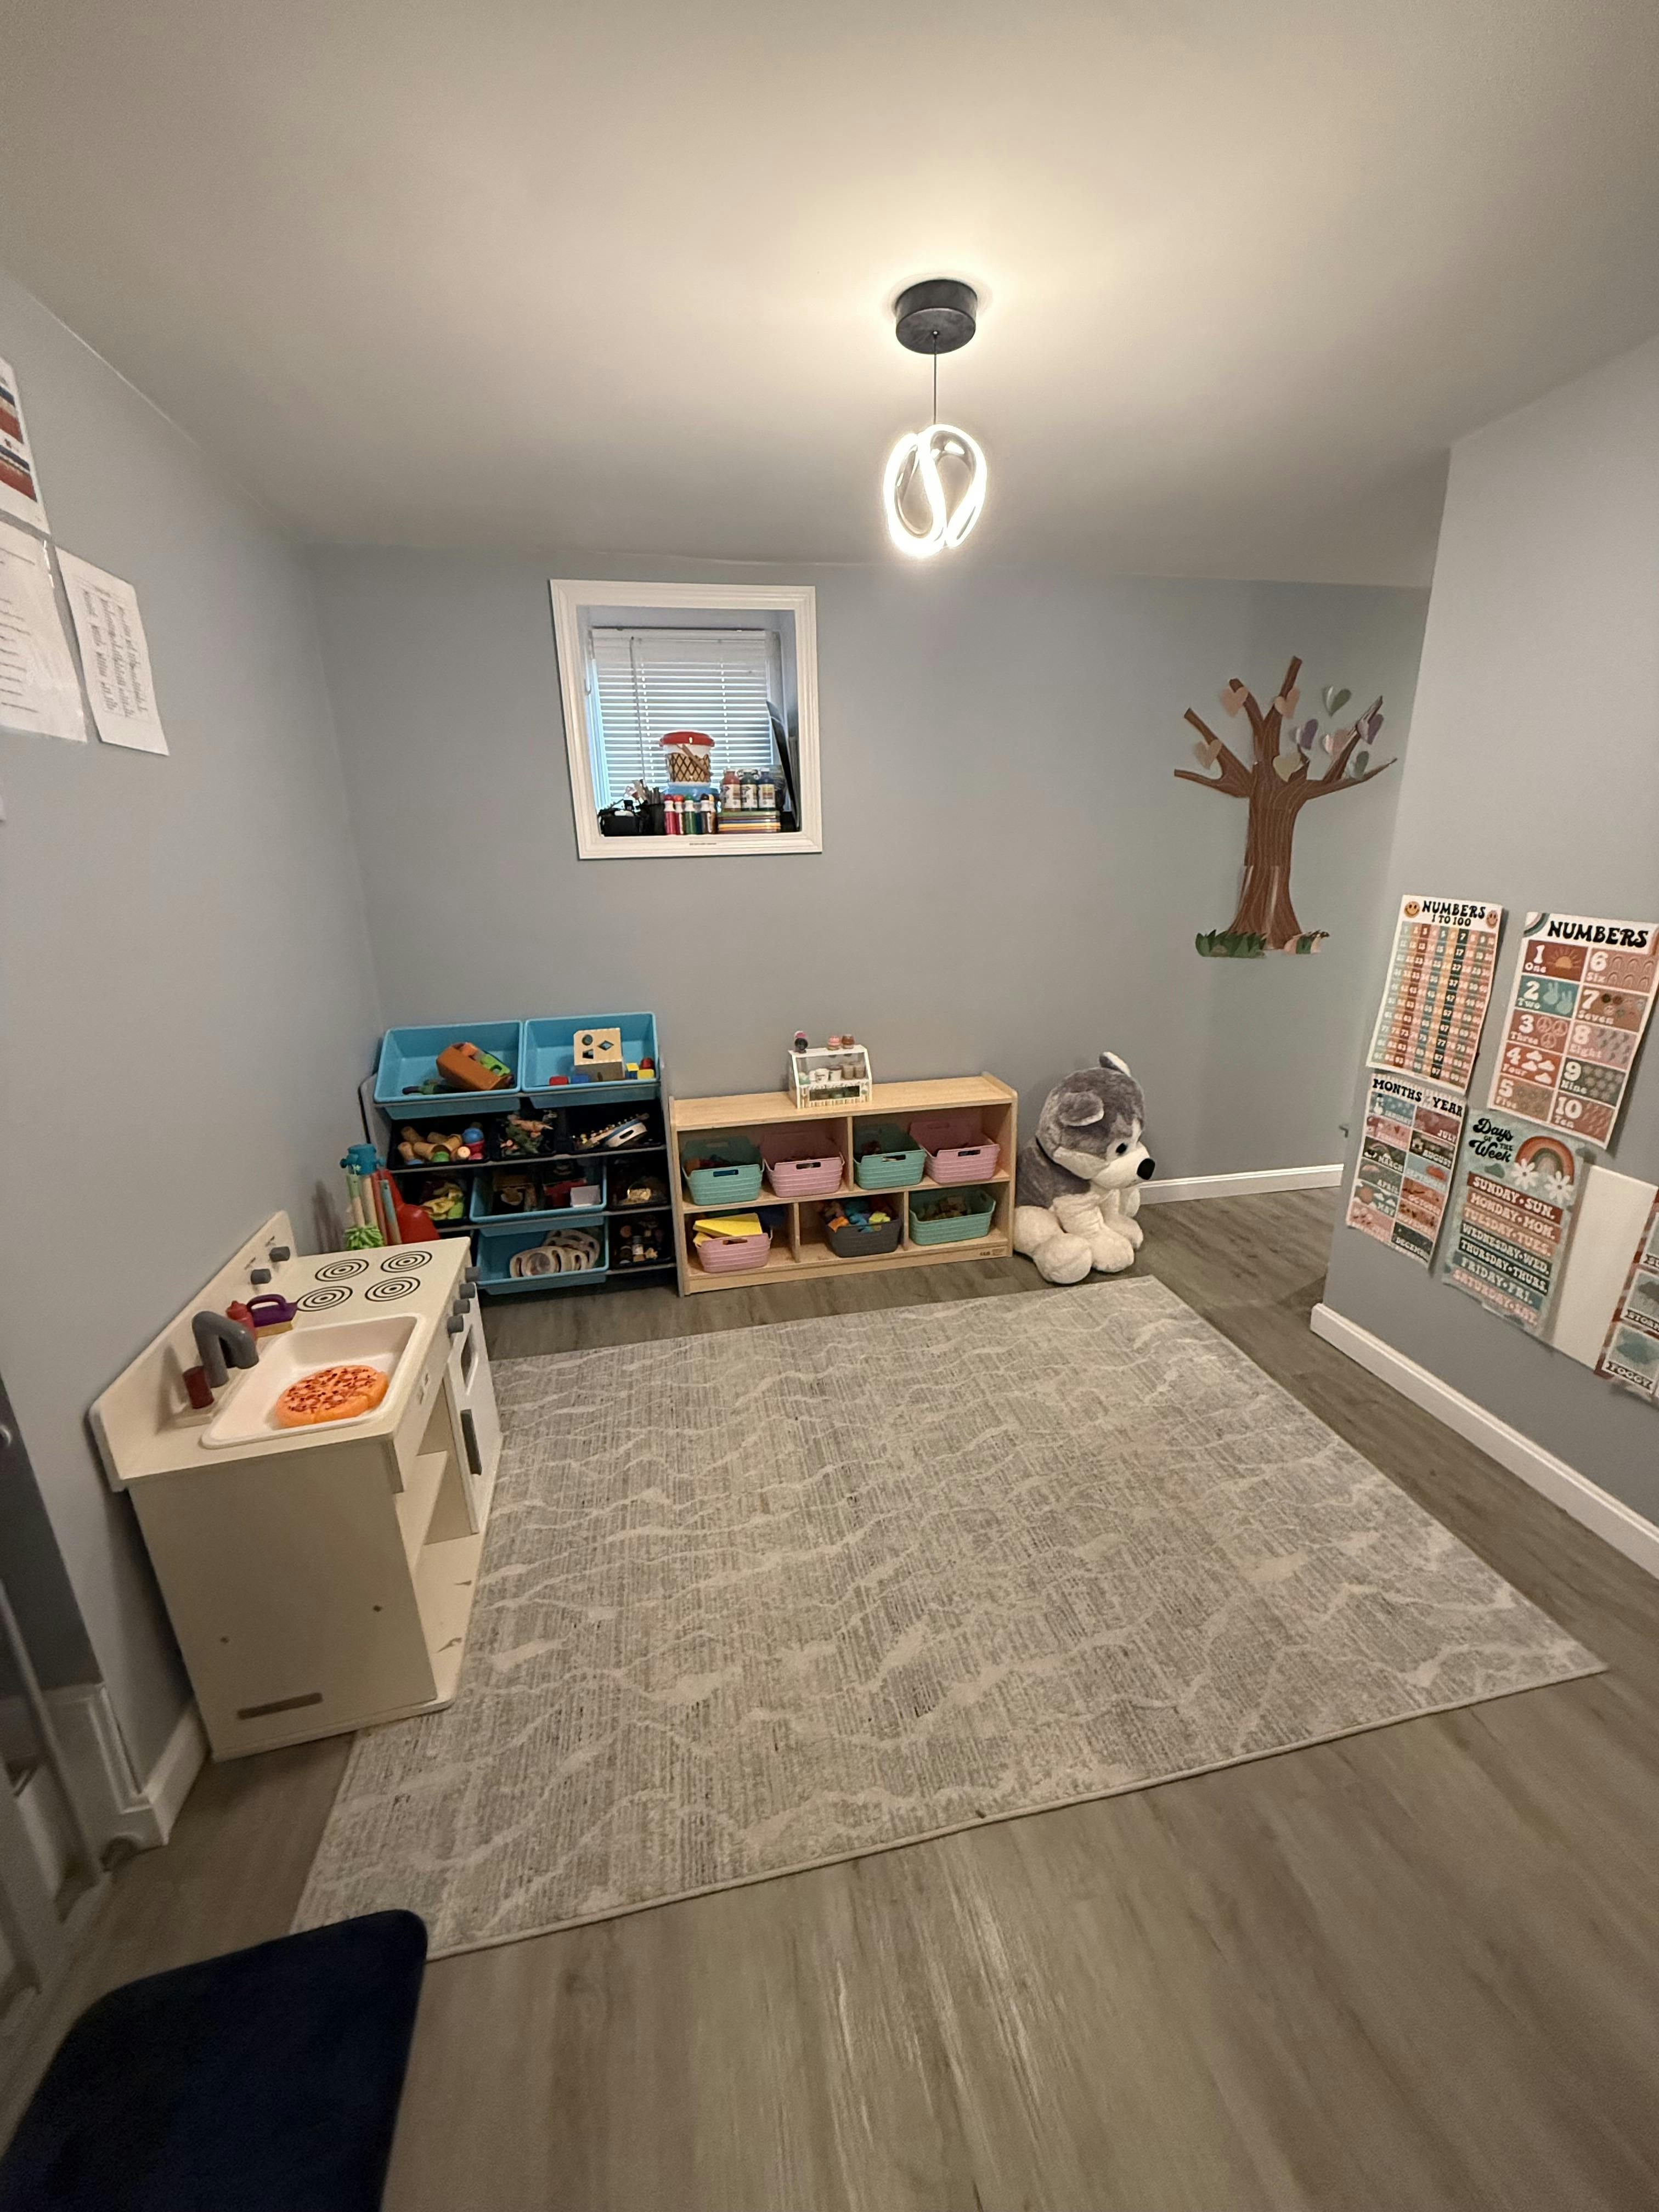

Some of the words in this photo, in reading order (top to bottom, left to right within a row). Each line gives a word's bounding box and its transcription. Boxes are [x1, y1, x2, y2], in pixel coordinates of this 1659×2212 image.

[1422, 900, 1486, 919] NUMBERS
[1439, 915, 1451, 924] TO
[1453, 918, 1471, 927] 100
[1548, 921, 1649, 948] NUMBERS
[1533, 945, 1545, 964] 1
[1590, 951, 1609, 972] 6
[1525, 962, 1547, 973] One
[1585, 972, 1606, 983] Six
[1523, 981, 1539, 1000] 2
[1581, 990, 1600, 1009] 7
[1517, 997, 1541, 1009] Two
[1519, 1014, 1534, 1034] 3
[1577, 1010, 1614, 1024] Seven
[1511, 1031, 1538, 1045] Three
[1573, 1024, 1591, 1044] 8
[1506, 1047, 1521, 1065] 4
[1570, 1044, 1602, 1058] Eight
[1502, 1064, 1527, 1076] Four
[1564, 1062, 1581, 1081] 9
[1498, 1079, 1514, 1098] 5
[1560, 1079, 1587, 1094] Nine
[1372, 1079, 1422, 1102] MONTHS
[1432, 1097, 1463, 1117] YEAR
[1494, 1097, 1517, 1109] Five
[1555, 1097, 1582, 1119] 10
[1472, 1118, 1514, 1142] Days
[1551, 1116, 1574, 1128] Ten
[1437, 1130, 1457, 1143] JULY
[1469, 1139, 1512, 1163] Week
[1473, 1176, 1520, 1203] SUNDAY
[1378, 1201, 1395, 1215] MAY
[1470, 1193, 1519, 1222] MONDAY
[1462, 1223, 1521, 1259] WEDNESDAY
[1461, 1239, 1510, 1271] THURSDAY
[1461, 1257, 1504, 1287] FRIDAY
